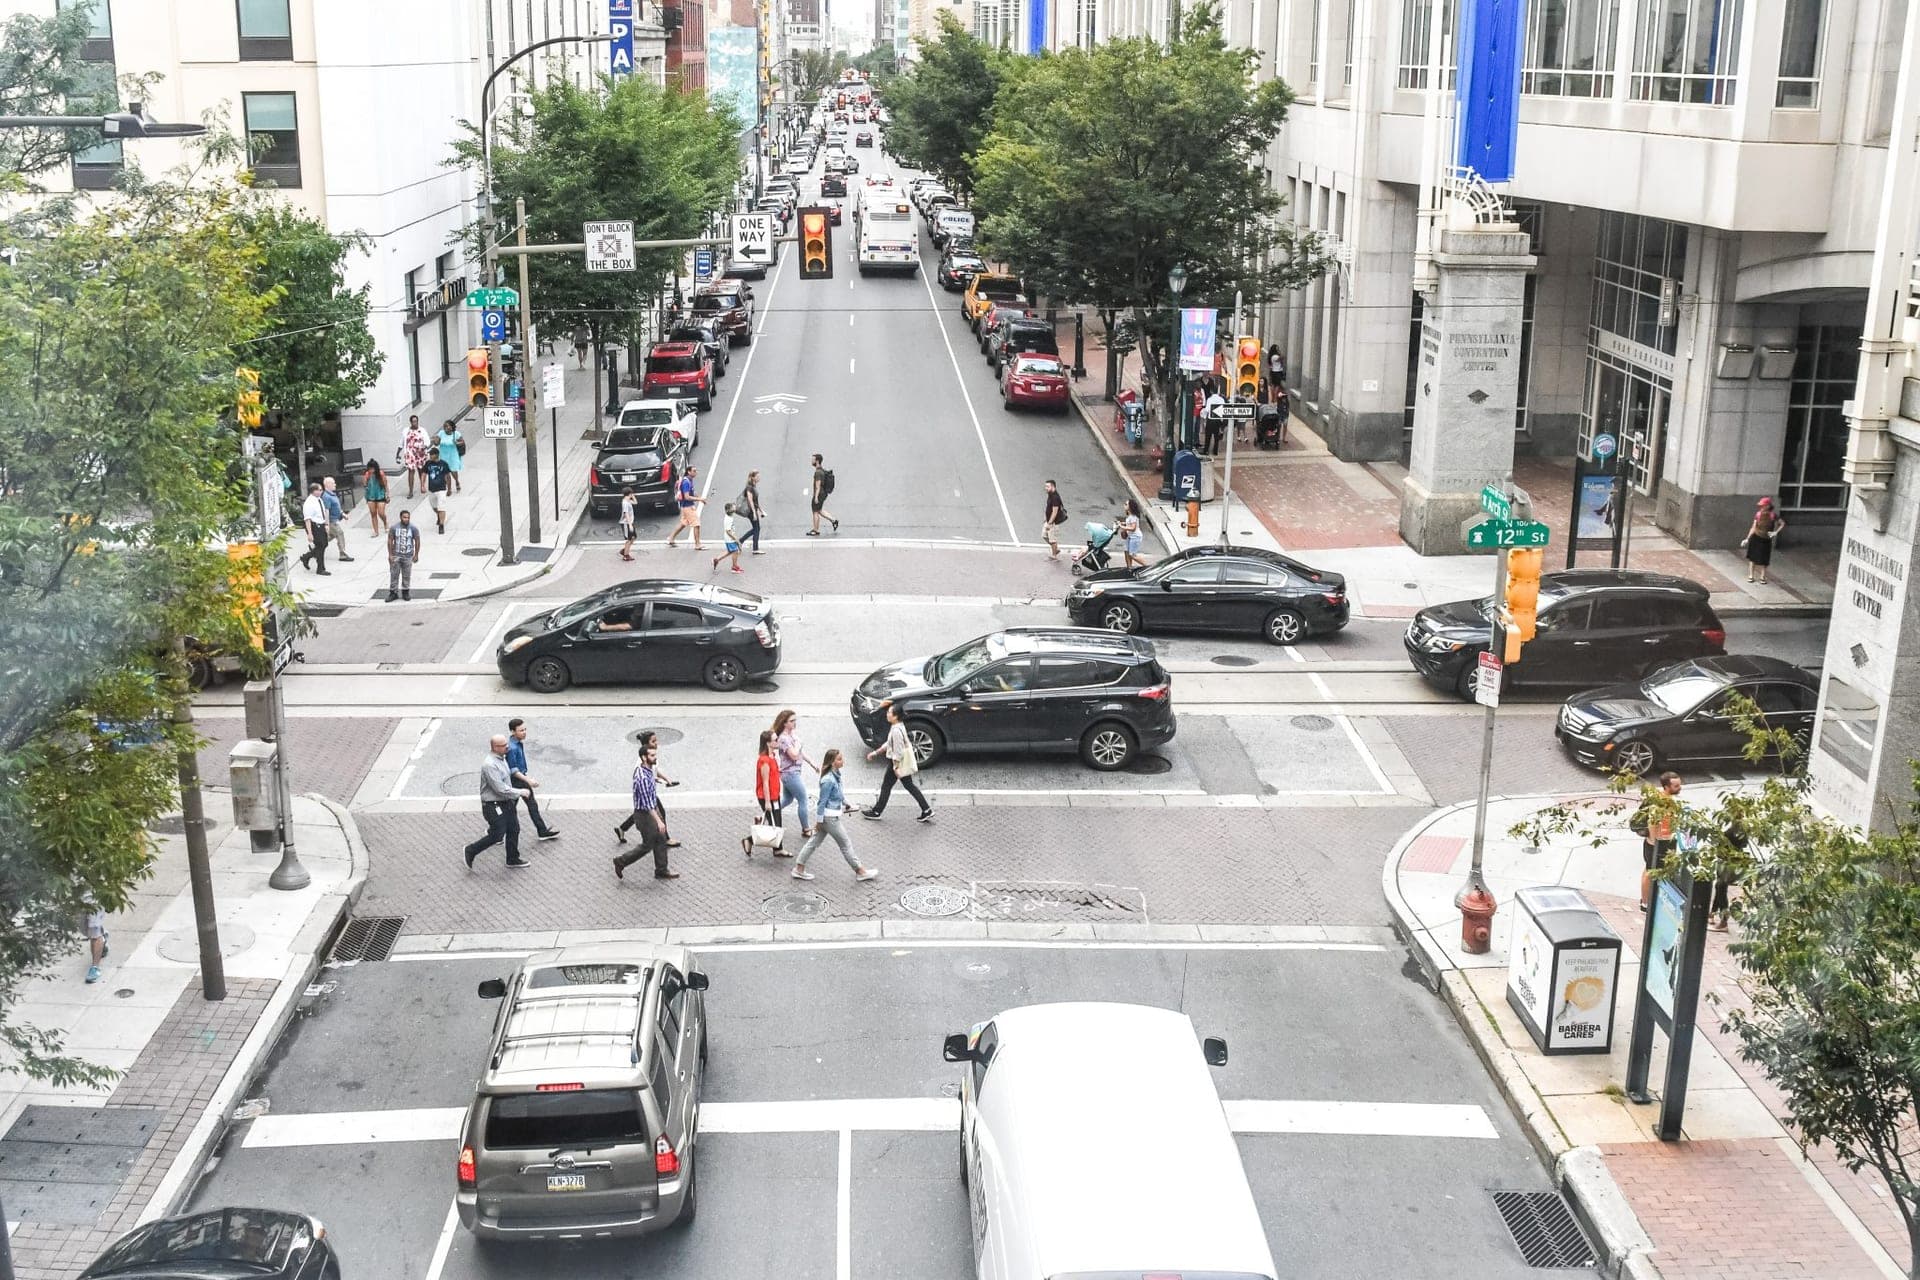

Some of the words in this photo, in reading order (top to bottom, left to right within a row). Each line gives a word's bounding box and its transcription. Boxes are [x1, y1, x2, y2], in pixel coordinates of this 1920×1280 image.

[608, 224, 631, 232] BLOCK
[739, 218, 764, 230] ONE
[739, 231, 765, 242] WAY
[590, 260, 608, 269] THE
[612, 258, 632, 269] BOX
[506, 296, 515, 304] St
[489, 316, 497, 325] P
[1449, 332, 1516, 345] PENNSYLVANIA
[1454, 347, 1508, 358] CONVENTION
[1487, 497, 1501, 520] Arch
[395, 528, 413, 537] USA
[1496, 529, 1525, 545] 12th
[1531, 532, 1545, 543] St
[395, 537, 412, 545] USA
[1847, 537, 1903, 581] PENNSYLVANIA
[1848, 562, 1896, 601] CONVENTION
[1853, 589, 1882, 620] CENTER
[1559, 1024, 1601, 1032] BARBERA
[1564, 1031, 1594, 1039] CARES
